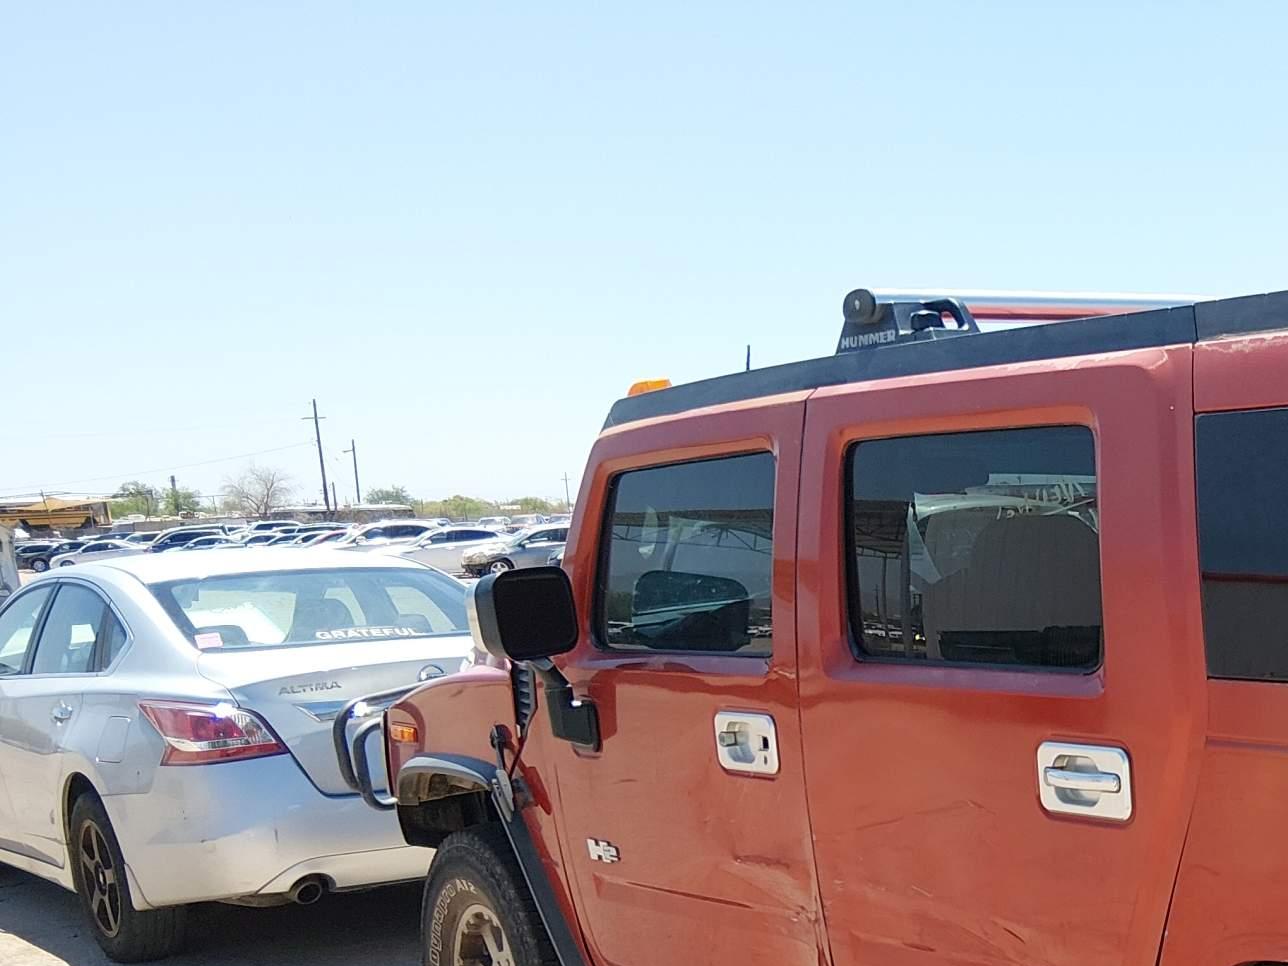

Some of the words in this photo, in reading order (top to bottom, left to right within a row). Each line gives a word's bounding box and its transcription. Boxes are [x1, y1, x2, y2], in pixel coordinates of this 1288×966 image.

[841, 328, 896, 349] HUMMER
[315, 627, 426, 641] GRATEFUL
[278, 681, 341, 696] ALTIMA
